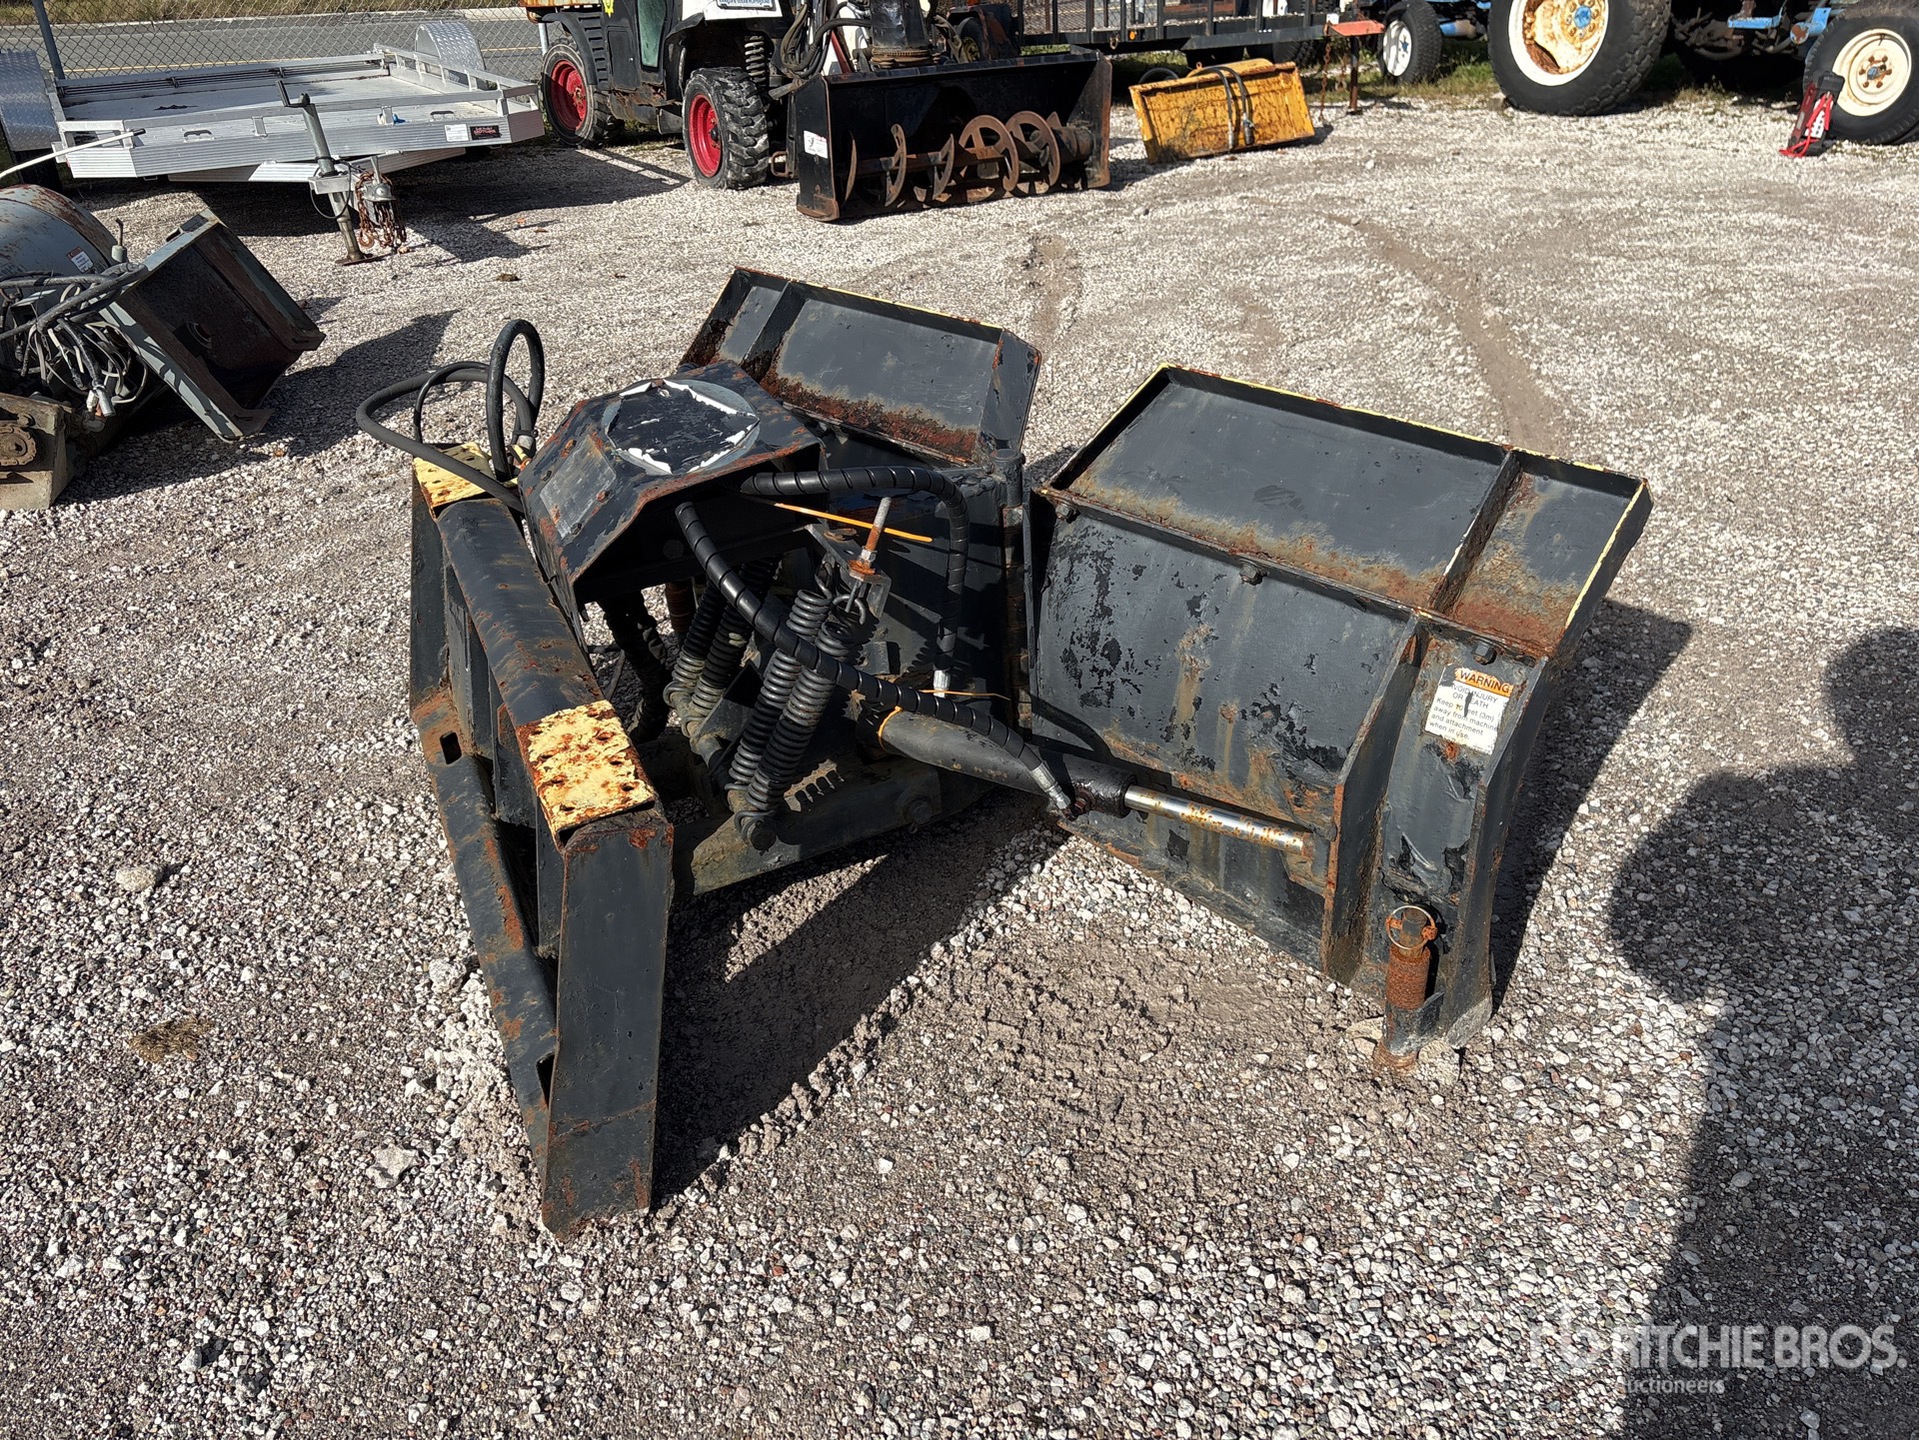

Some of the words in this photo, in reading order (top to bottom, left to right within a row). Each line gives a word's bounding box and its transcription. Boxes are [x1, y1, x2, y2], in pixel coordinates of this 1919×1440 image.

[1450, 685, 1471, 695] VOID
[1460, 670, 1510, 694] WARNING
[1436, 697, 1454, 708] Keep
[1479, 711, 1495, 723] (3m)
[1452, 692, 1464, 700] OR
[1468, 697, 1489, 709] EATH
[1429, 721, 1447, 731] when
[1448, 726, 1455, 734] in
[1431, 713, 1445, 722] and
[1445, 718, 1484, 736] attachment
[1433, 706, 1452, 717] away
[1452, 711, 1468, 721] from
[1469, 717, 1498, 731] machine
